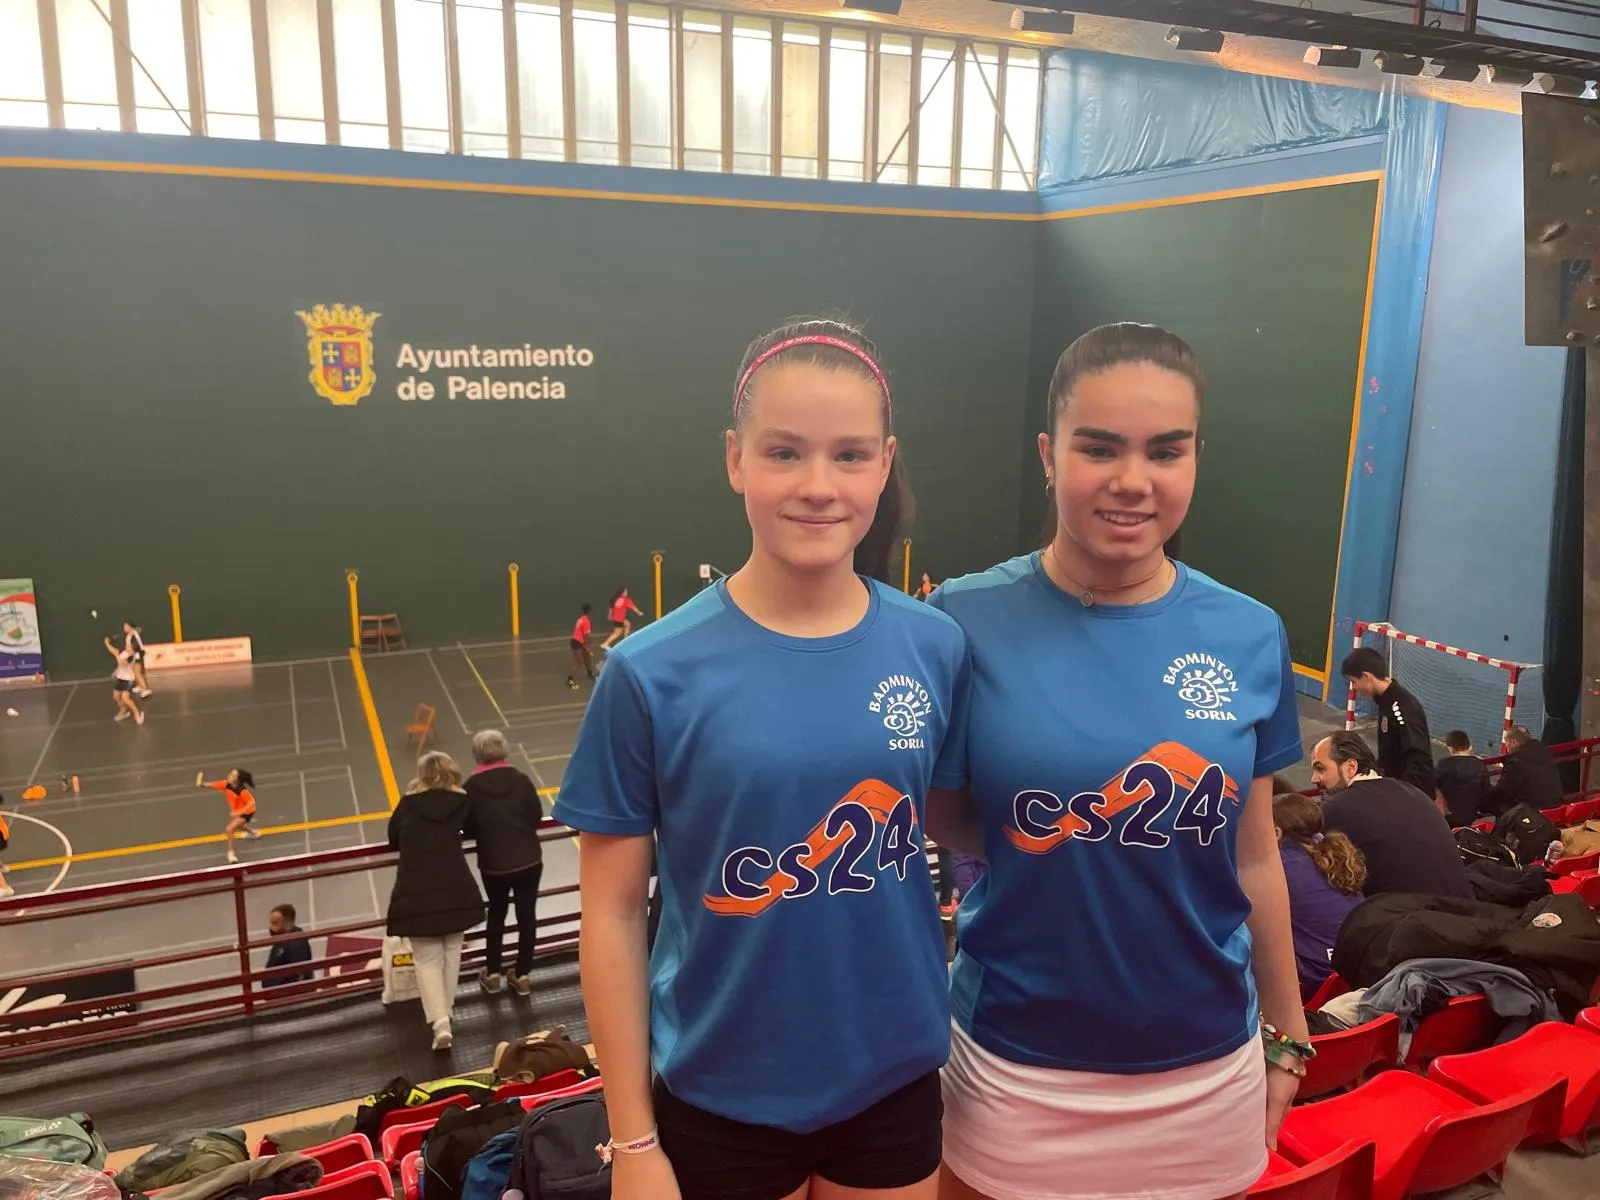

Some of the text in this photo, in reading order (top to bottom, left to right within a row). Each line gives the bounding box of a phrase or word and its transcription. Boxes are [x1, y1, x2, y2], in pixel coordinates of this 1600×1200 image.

[396, 343, 594, 373] Ayuntamiento
[397, 376, 566, 401] de Palencia
[1162, 652, 1239, 693] BADMINTON
[868, 673, 932, 714] BADMINTON
[1185, 708, 1238, 721] SORIA
[888, 737, 925, 751] SORIA
